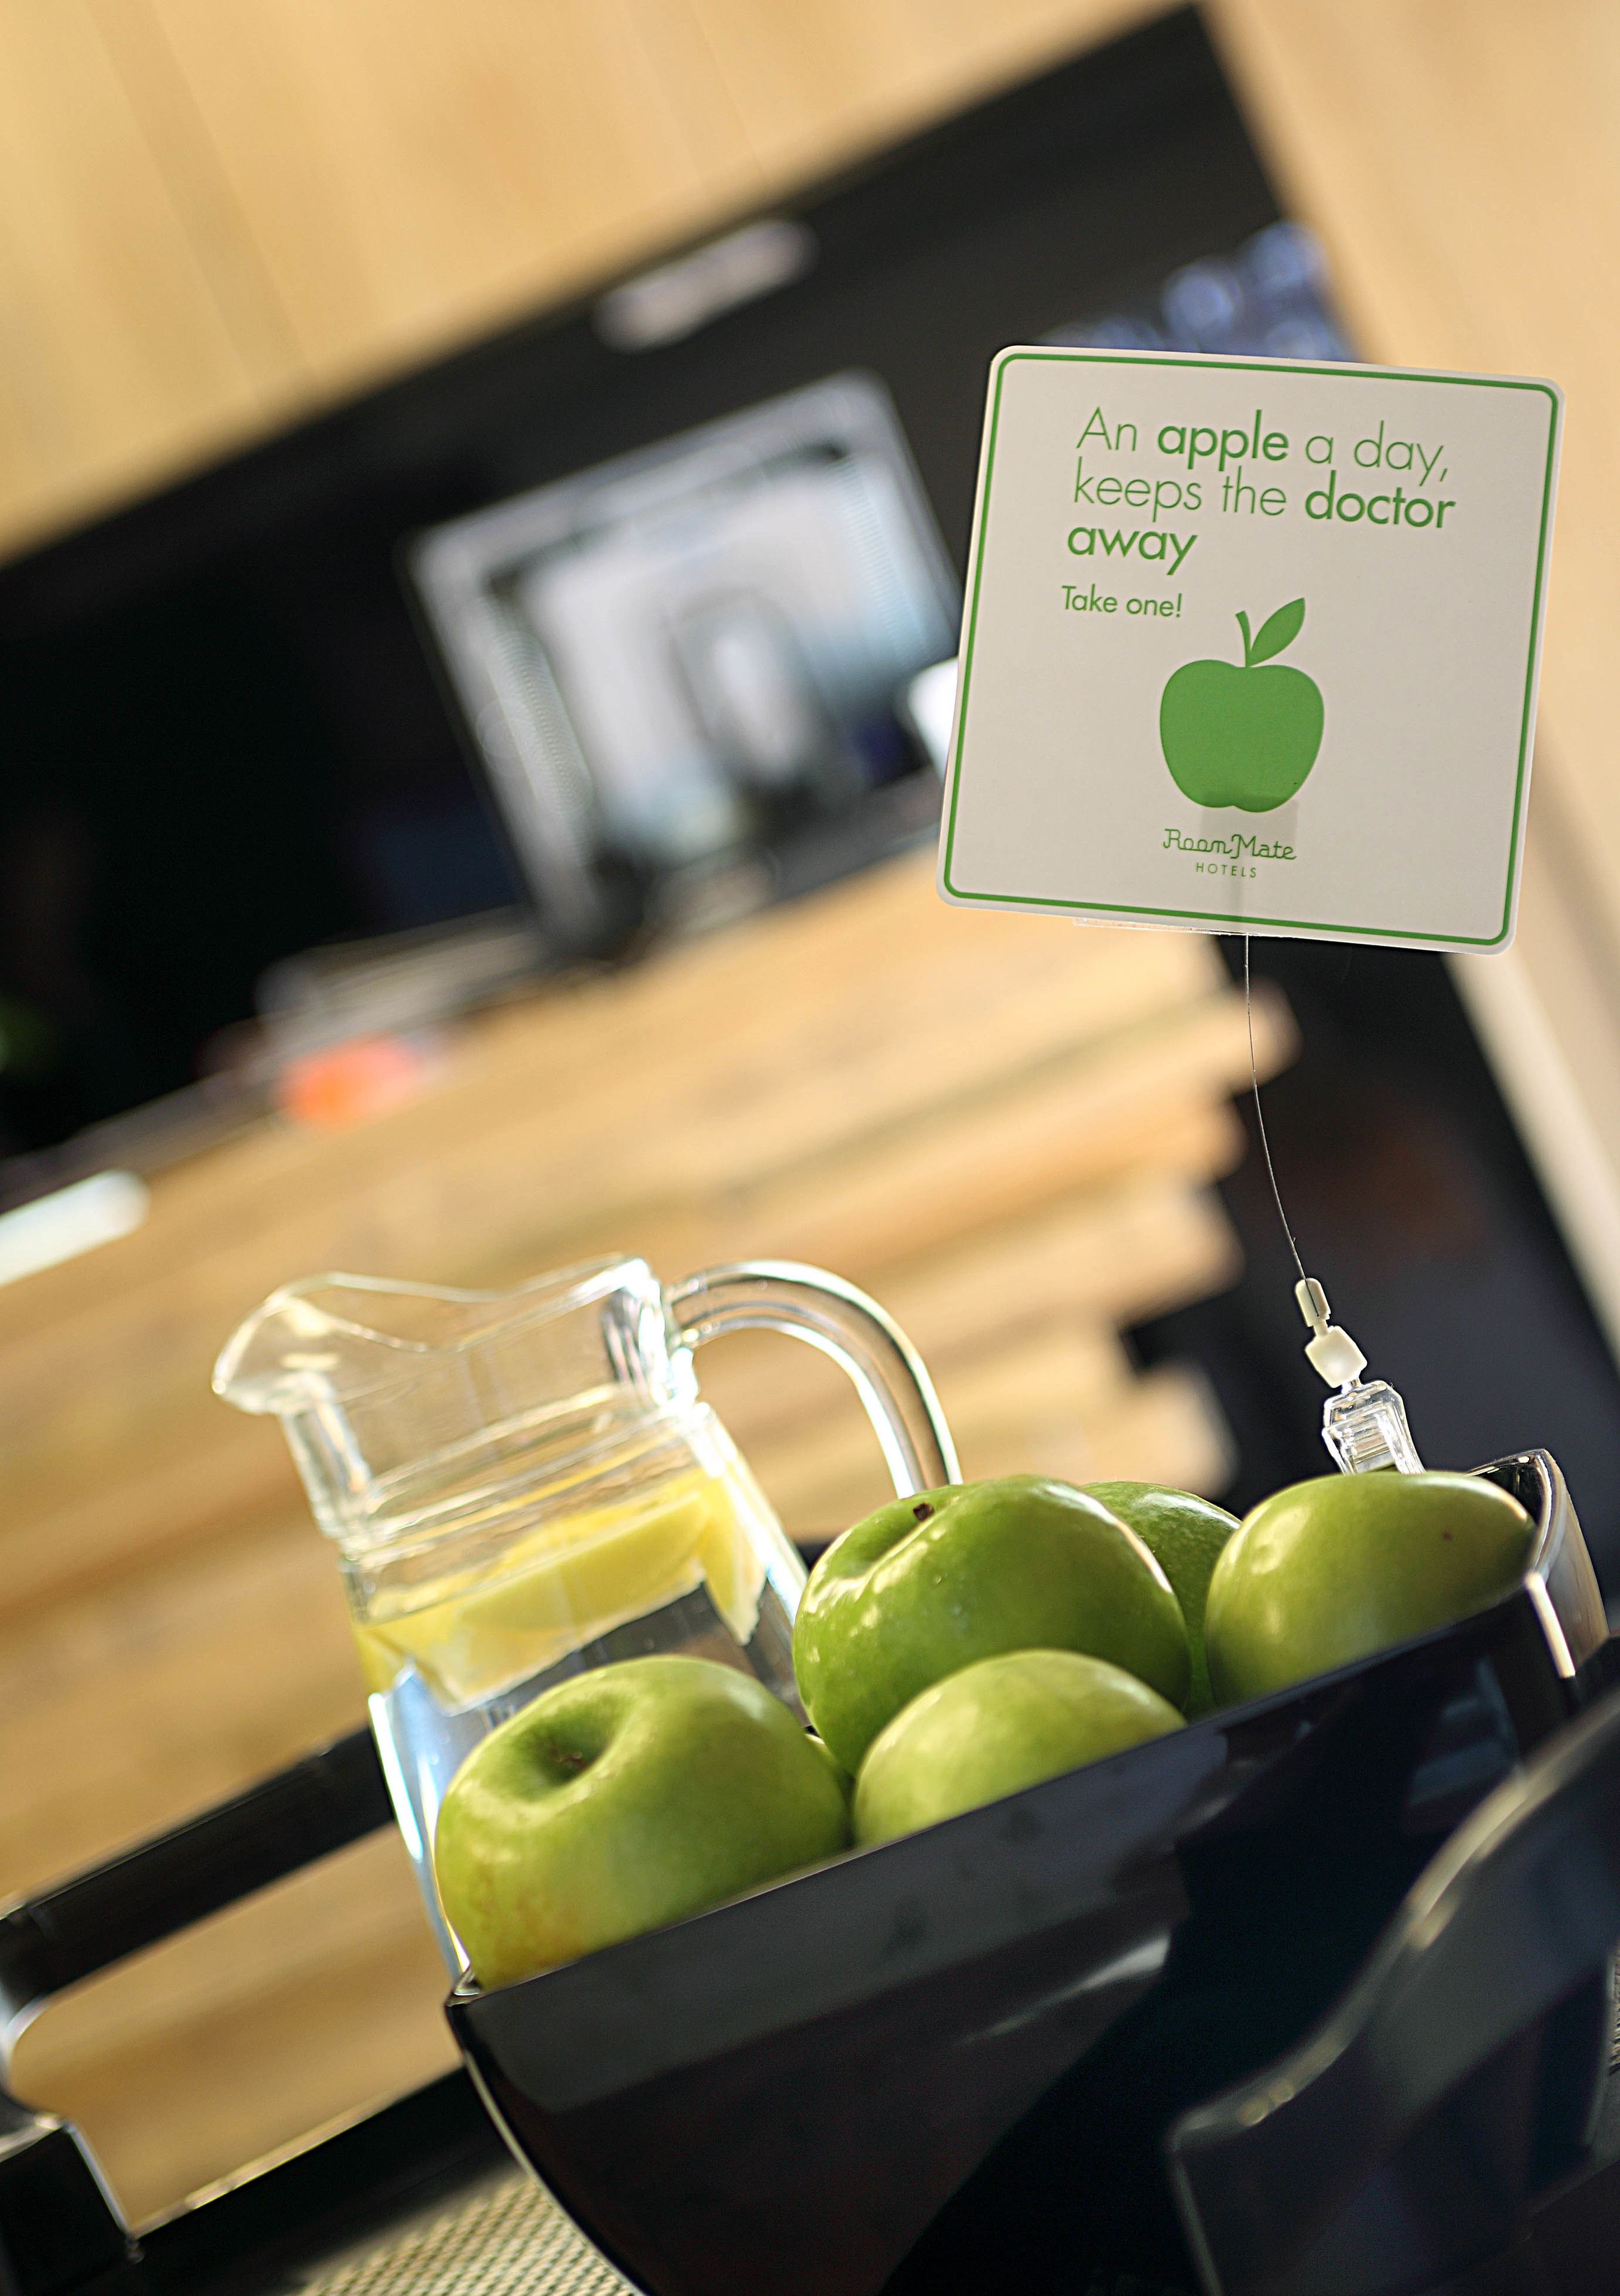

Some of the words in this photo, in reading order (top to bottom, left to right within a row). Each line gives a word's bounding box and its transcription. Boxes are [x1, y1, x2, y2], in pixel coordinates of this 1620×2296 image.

[1076, 407, 1137, 451] An
[1157, 410, 1289, 472] apple
[1305, 435, 1334, 464] a
[1354, 420, 1448, 486] day,
[1074, 456, 1202, 522] keeps
[1223, 465, 1286, 516] the
[1305, 470, 1456, 528] doctor
[1067, 527, 1198, 576] away
[1061, 584, 1118, 613] Take
[1126, 594, 1183, 618] one!
[1196, 862, 1256, 878] HOTELS
